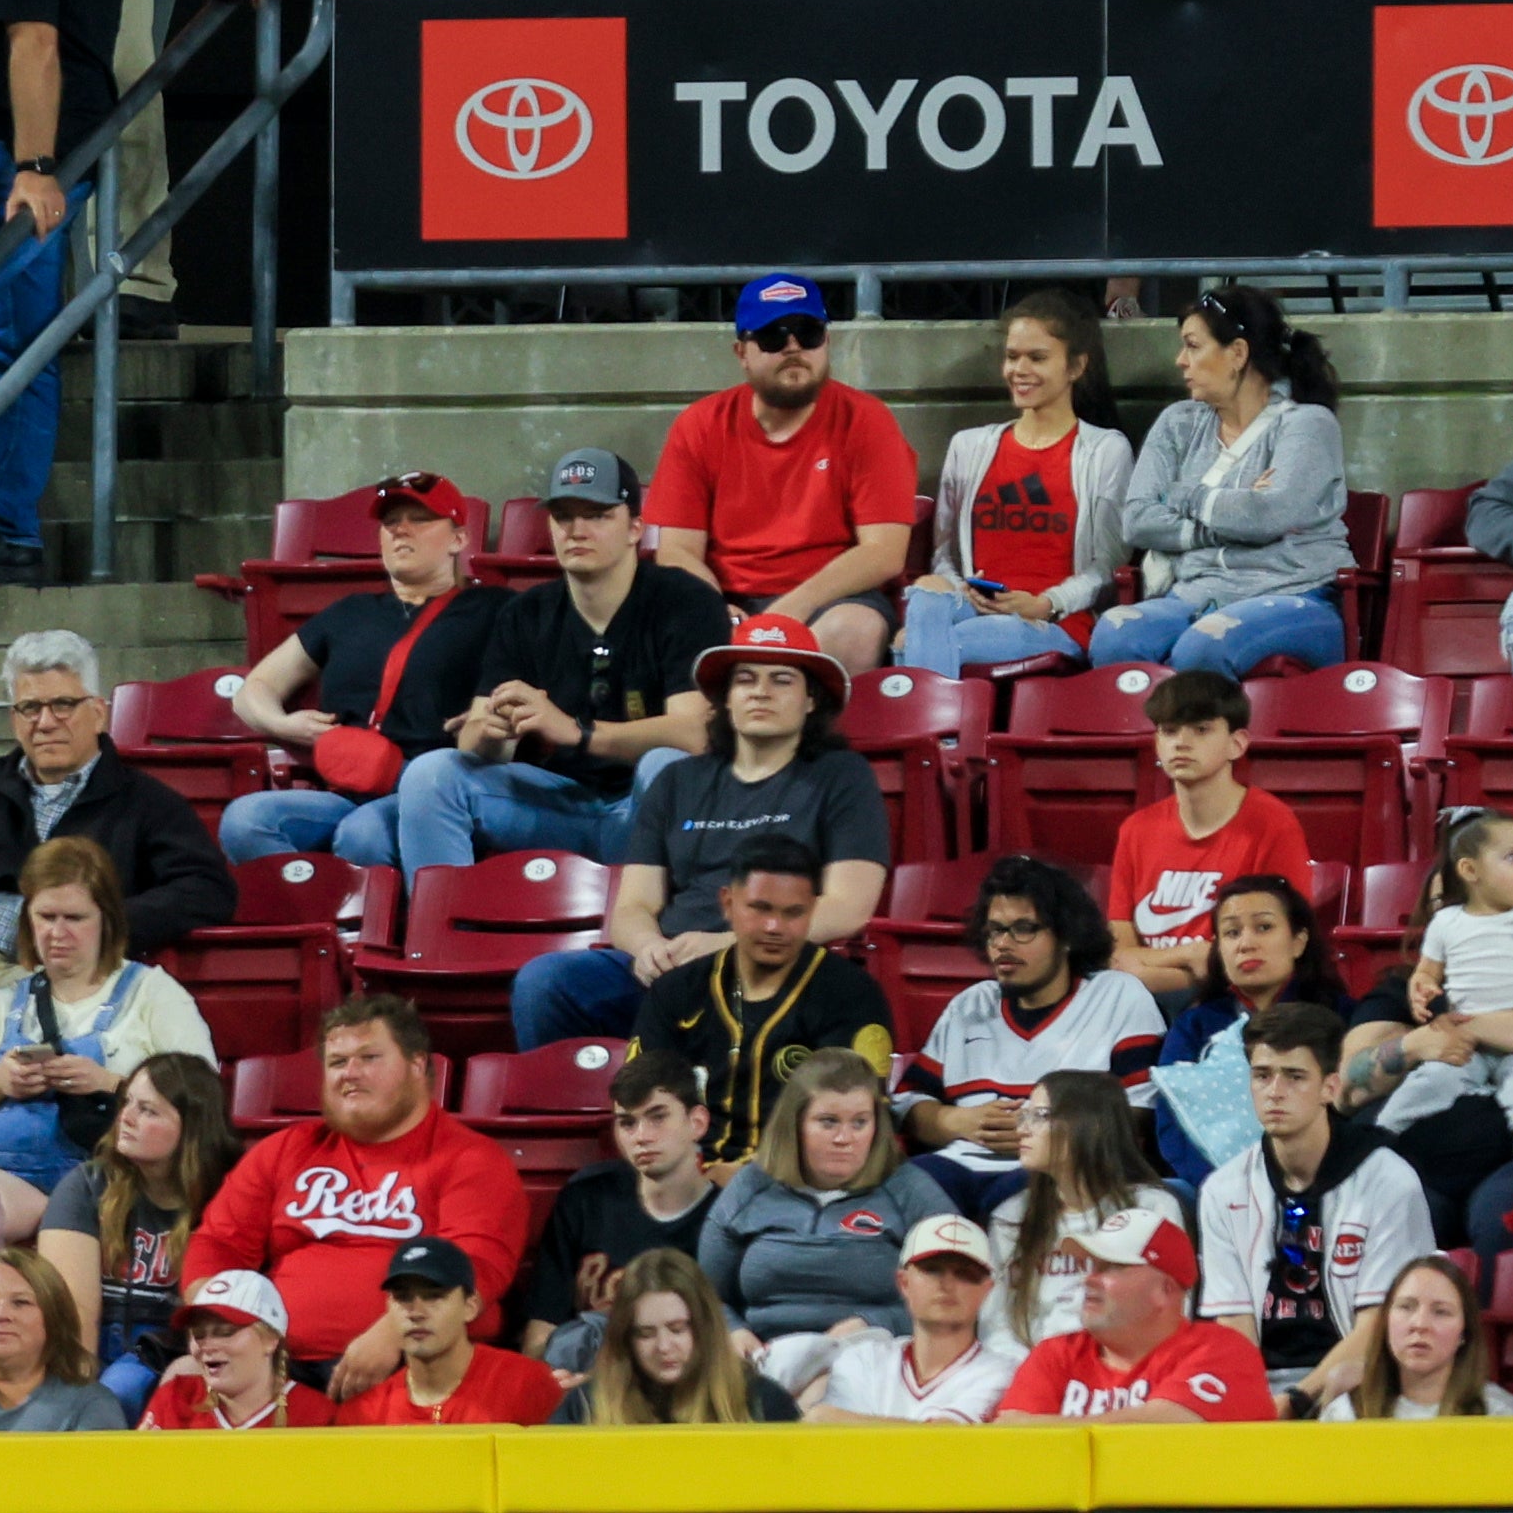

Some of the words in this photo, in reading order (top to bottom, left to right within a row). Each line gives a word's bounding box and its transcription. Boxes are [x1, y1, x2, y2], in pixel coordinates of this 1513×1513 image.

[674, 75, 1164, 173] TOYOTA
[560, 464, 596, 479] REDS
[975, 503, 1069, 534] adidas
[1152, 869, 1223, 908] NIKE
[286, 1166, 424, 1239] Reds
[1062, 1379, 1149, 1417] REDS
